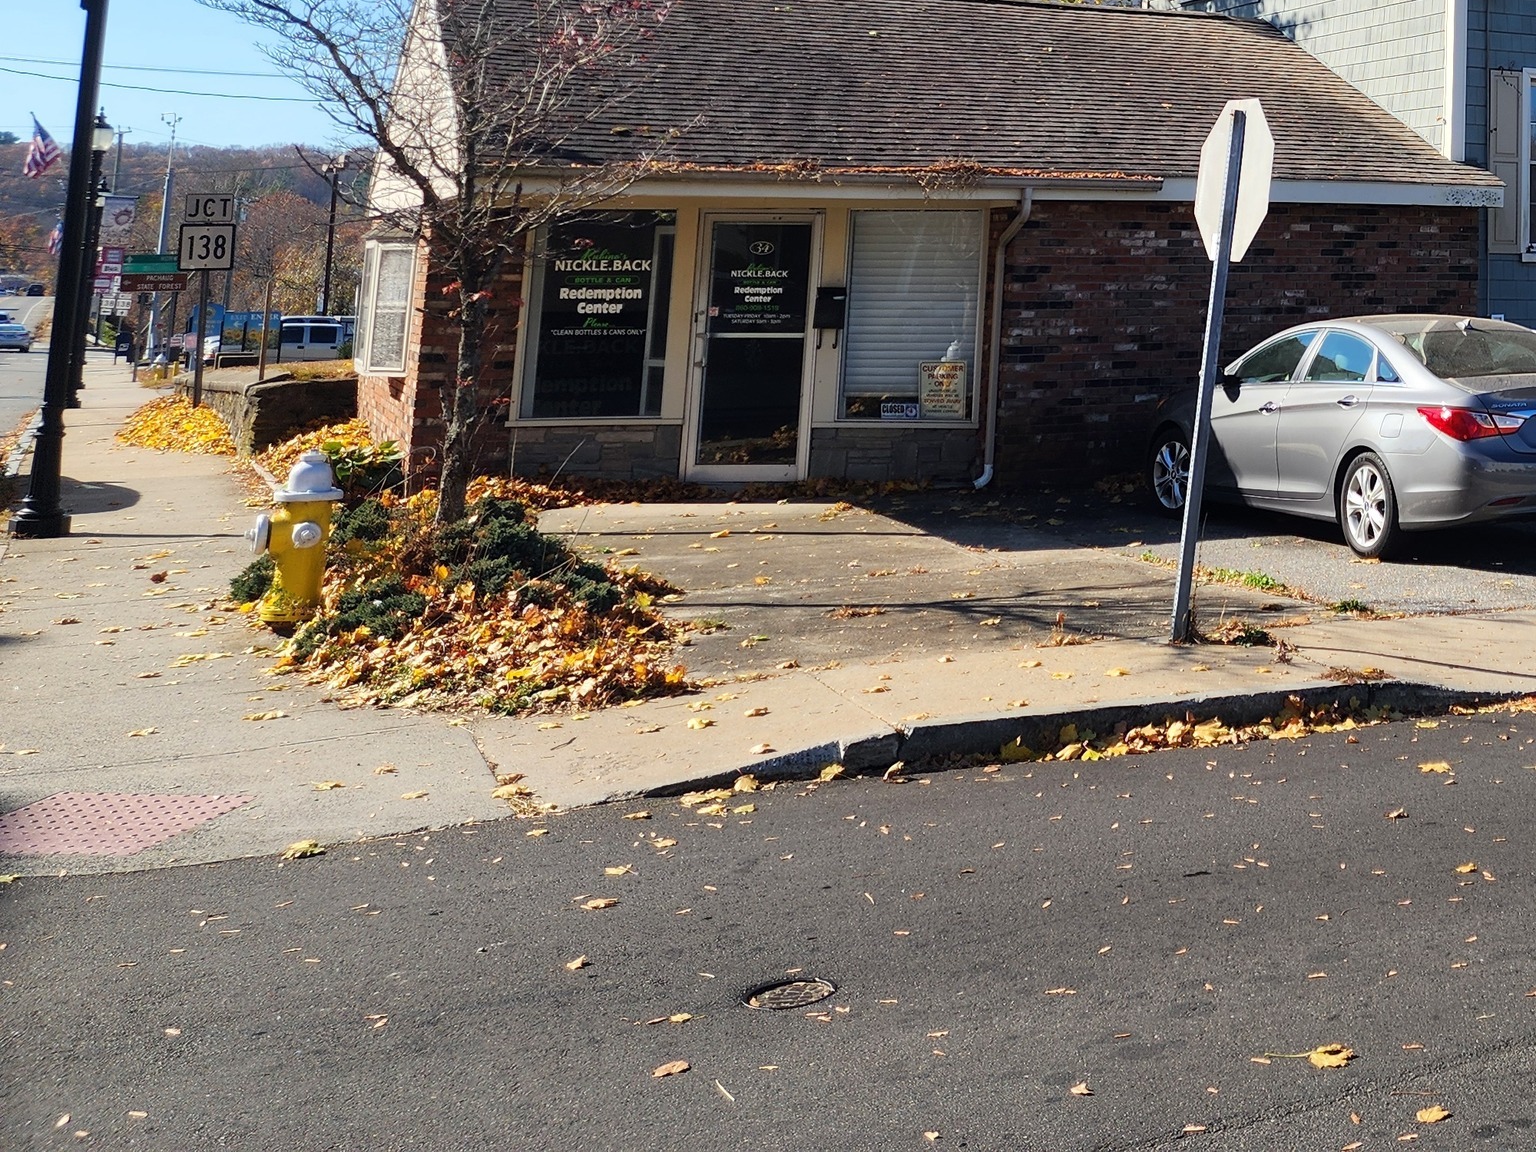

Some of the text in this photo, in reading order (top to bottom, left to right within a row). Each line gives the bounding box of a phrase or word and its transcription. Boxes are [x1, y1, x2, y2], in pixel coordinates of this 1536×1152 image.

[188, 198, 231, 217] JCT
[188, 235, 227, 260] 138
[756, 242, 770, 253] 34
[554, 260, 652, 271] NICKLE.BACK
[730, 270, 789, 278] NICKLE.BACK
[559, 287, 642, 301] Redemption
[733, 286, 783, 294] Redemption
[577, 302, 623, 314] Center
[882, 404, 905, 414] CLOSED
